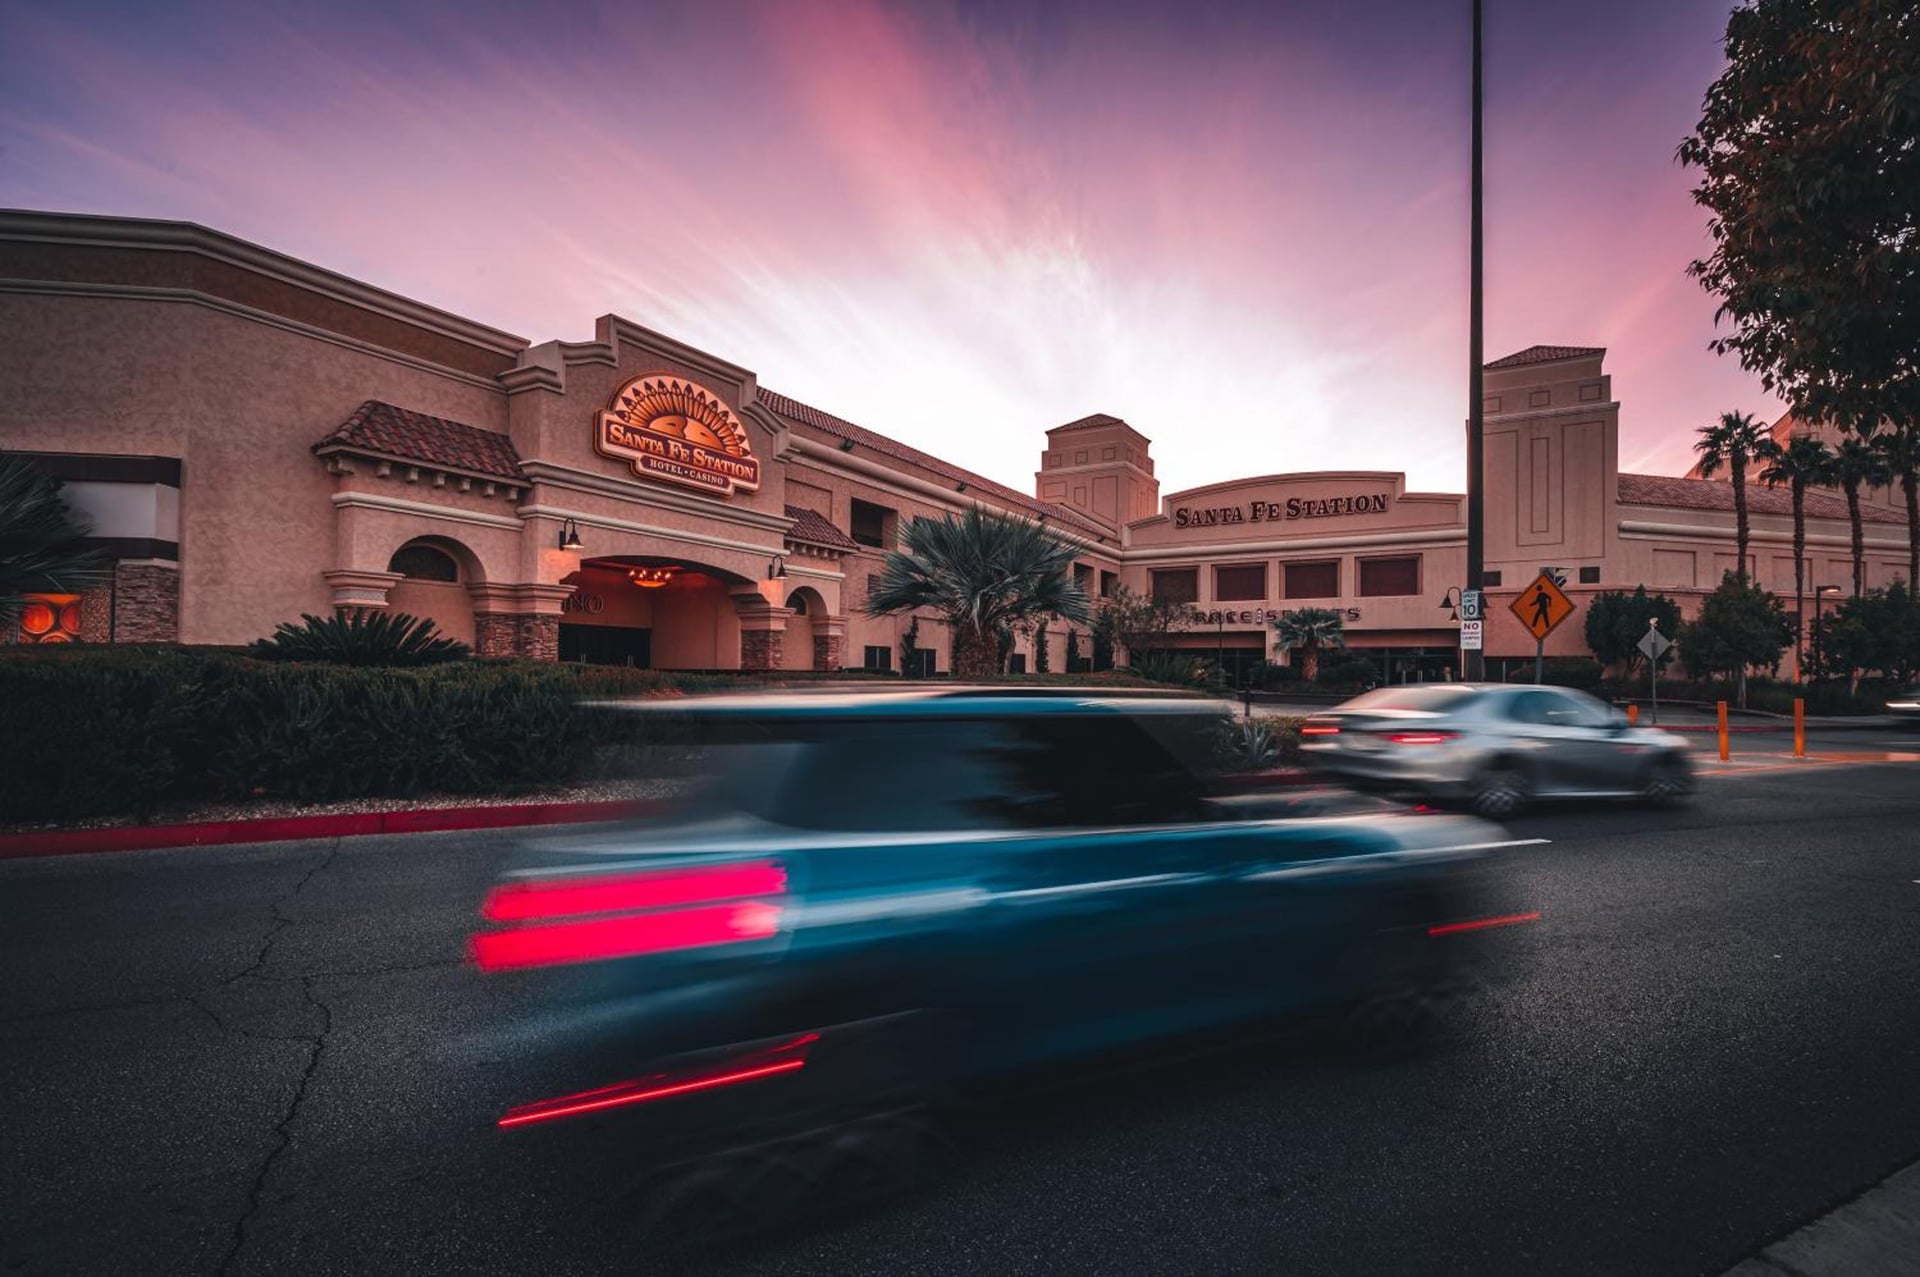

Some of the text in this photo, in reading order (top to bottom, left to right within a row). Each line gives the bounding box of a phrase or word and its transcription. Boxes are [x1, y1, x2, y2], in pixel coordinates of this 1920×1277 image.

[609, 423, 755, 480] SANTA FE STATION
[650, 459, 724, 486] HOTEL CASINO
[1175, 493, 1389, 528] SANTA FE STATION
[1463, 604, 1476, 616] 10
[1463, 622, 1479, 630] NO
